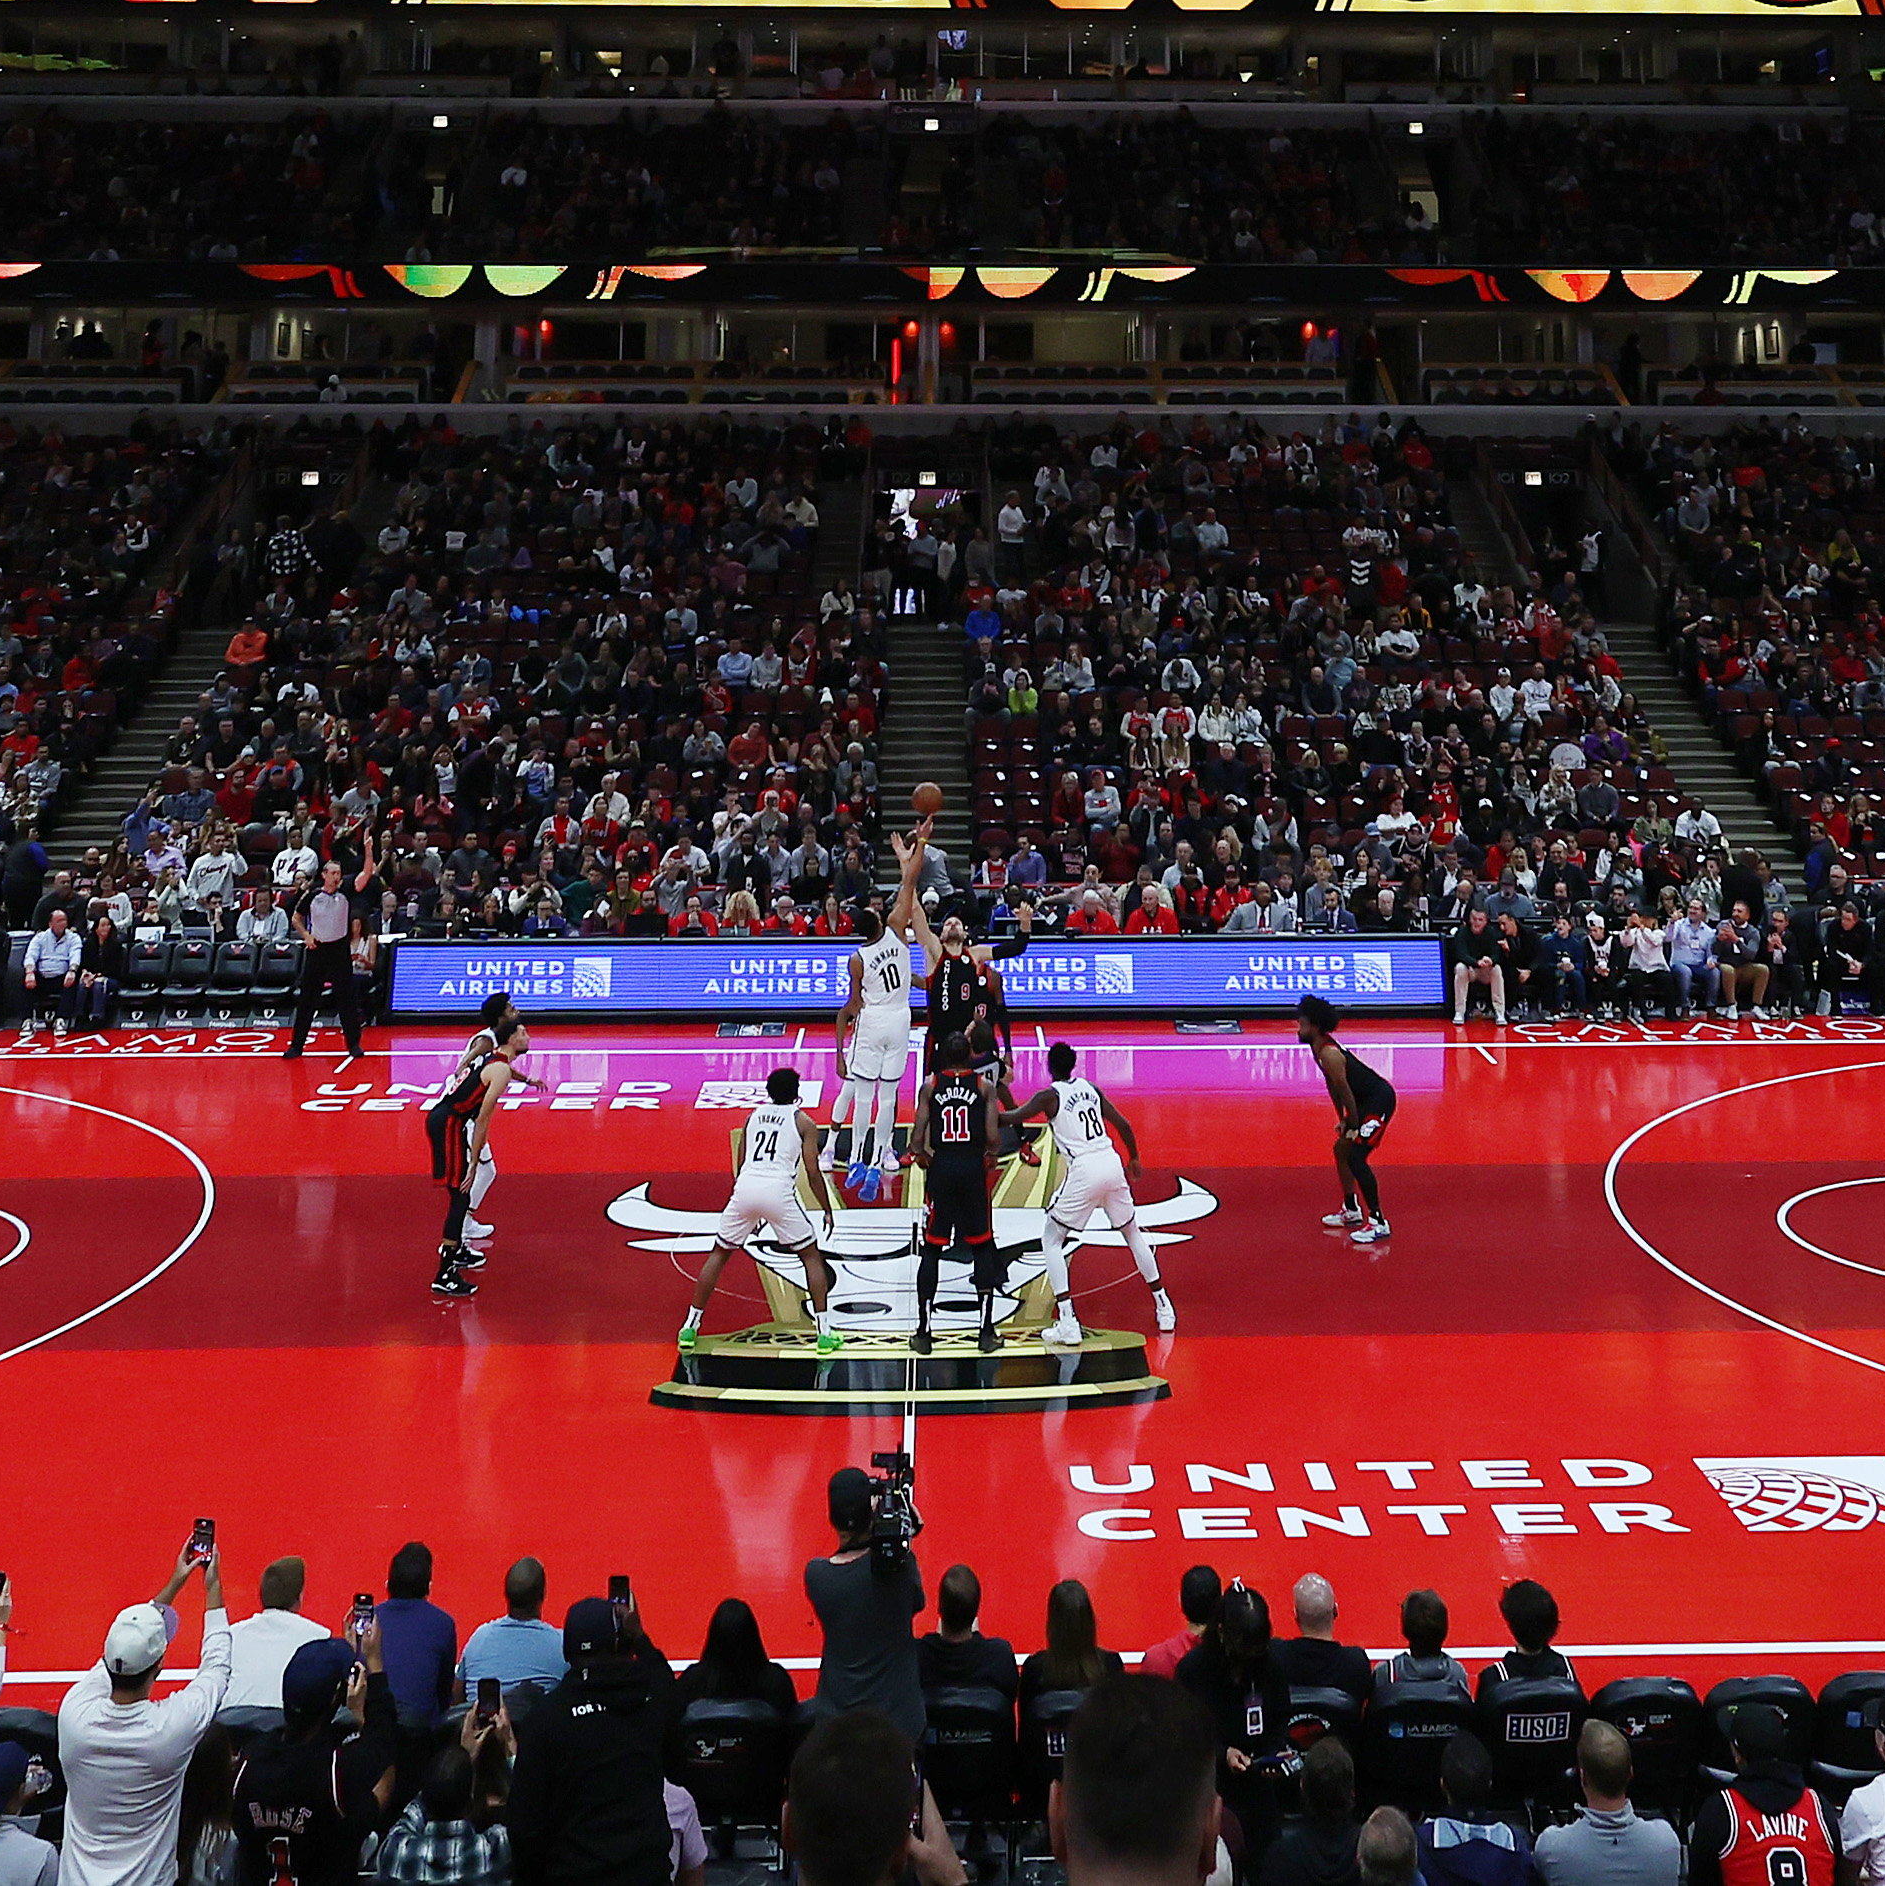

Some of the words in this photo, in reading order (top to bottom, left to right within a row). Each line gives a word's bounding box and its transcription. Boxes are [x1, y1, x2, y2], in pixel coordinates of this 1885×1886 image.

[466, 960, 565, 977] UNITED
[729, 958, 829, 975] UNITED
[1248, 954, 1346, 972] UNITED
[438, 978, 566, 996] AIRLINES
[703, 976, 830, 995] AIRLINES
[879, 963, 902, 993] 10
[942, 958, 952, 1012] CHICAGO
[1224, 974, 1347, 992] AIRLINES
[960, 982, 971, 1002] 9
[935, 1086, 979, 1106] DeROZAN
[757, 1115, 786, 1127] THOMAS
[941, 1104, 971, 1142] 11
[1077, 1107, 1103, 1141] 28
[752, 1129, 779, 1163] 24
[1067, 1458, 1656, 1493] UNITED
[1076, 1501, 1693, 1542] CENTER
[1421, 1723, 1459, 1734] RABIDA
[1519, 1717, 1555, 1739] USO
[248, 1801, 316, 1835] ROSE
[1746, 1813, 1810, 1843] LAVINE
[266, 1836, 299, 1886] 1
